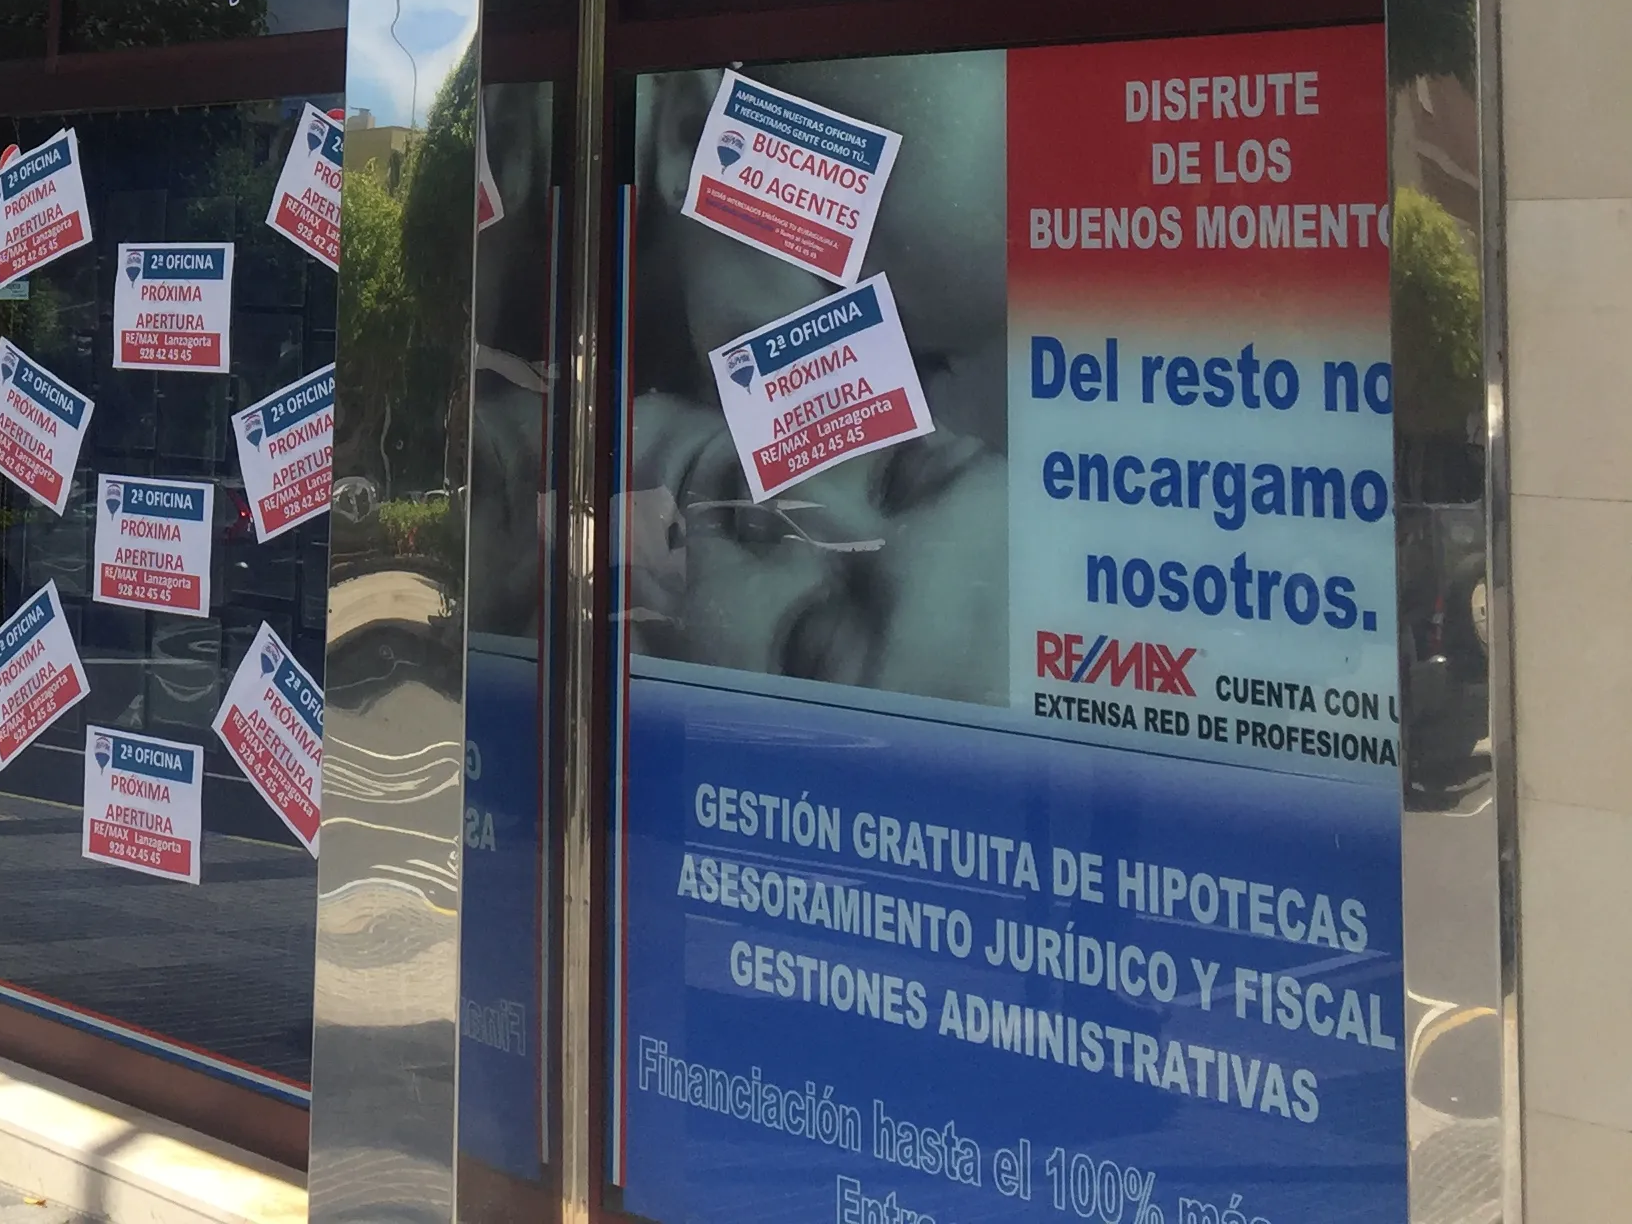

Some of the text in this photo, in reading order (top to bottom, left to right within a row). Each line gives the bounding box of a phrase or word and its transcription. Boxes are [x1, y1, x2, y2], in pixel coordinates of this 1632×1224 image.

[735, 90, 867, 148] AMPLIAMOS NUESTRAS OFICINAS
[1126, 71, 1319, 122] DISFRUTE
[741, 106, 792, 135] NECESITAMOS
[792, 127, 819, 146] GENTE
[821, 140, 850, 157] COMO
[7, 146, 61, 188] 2ª OFICINA
[752, 132, 869, 195] BUSCAMOS
[1152, 138, 1292, 185] DE LOS
[3, 176, 56, 221] PRÓXIMA
[285, 197, 321, 229] RE/MAX
[739, 166, 763, 189] 40
[766, 177, 860, 230] AGENTES
[4, 201, 64, 247] APERTURA
[32, 215, 73, 250] Lanzagorta
[1030, 206, 1182, 250] BUENOS
[151, 254, 213, 269] 2ª OFICINA
[140, 281, 201, 302] PRÓXIMA
[124, 332, 211, 350] RE/MAX Lanzagorta
[135, 312, 204, 330] APERTURA
[766, 301, 863, 359] 2ª OFICINA
[33, 373, 75, 415] OFICINA
[765, 344, 858, 402] PRÓXIMA
[1031, 336, 1119, 402] Del
[1142, 342, 1300, 410] resto
[6, 384, 59, 437] PRÓXIMA
[270, 377, 335, 423] 2ª OFICINA
[773, 377, 873, 439] APERTURA
[269, 414, 333, 459] PRÓXIMA
[760, 398, 892, 466] RE/MAX Lanzagorta
[788, 425, 865, 473] 928 42 45 45
[15, 444, 55, 485] Lanzagorta
[131, 487, 193, 509] 2ª OFICINA
[263, 483, 301, 513] RE/MAX
[1043, 450, 1395, 531] encargamo
[120, 515, 181, 542] PRÓXIMA
[114, 545, 184, 571] APERTURA
[144, 570, 190, 592] Lanzagorta
[1087, 551, 1377, 631] nosotros.
[3, 602, 44, 650] OFICINA
[27, 672, 68, 718] Lanzagorta
[284, 670, 301, 690] 2ª
[1216, 676, 1316, 713] CUENTA
[1324, 689, 1379, 721] CON
[263, 687, 323, 768] PRÓXIMA
[1034, 692, 1400, 767] EXTENSA RED DE PROFESIONA
[119, 742, 182, 771] 2ª OFICINA
[232, 711, 314, 818] RE/MAX Lanzagorta
[238, 741, 289, 808] 928 42 45 45
[248, 709, 312, 796] APERTURA
[109, 769, 170, 803] PRÓXIMA
[104, 801, 174, 834] APERTURA
[133, 829, 181, 857] Lanzagorta
[695, 782, 1369, 953] GESTIÓN GRATUITA DE HIPOTECAS
[678, 855, 1396, 1051] ASESORAMIENTO JURÍDICO Y FISCAL
[730, 941, 1320, 1124] GESTIONES ADMINISTRATIVAS
[639, 1036, 1163, 1224] Financiación hasta el 100%
